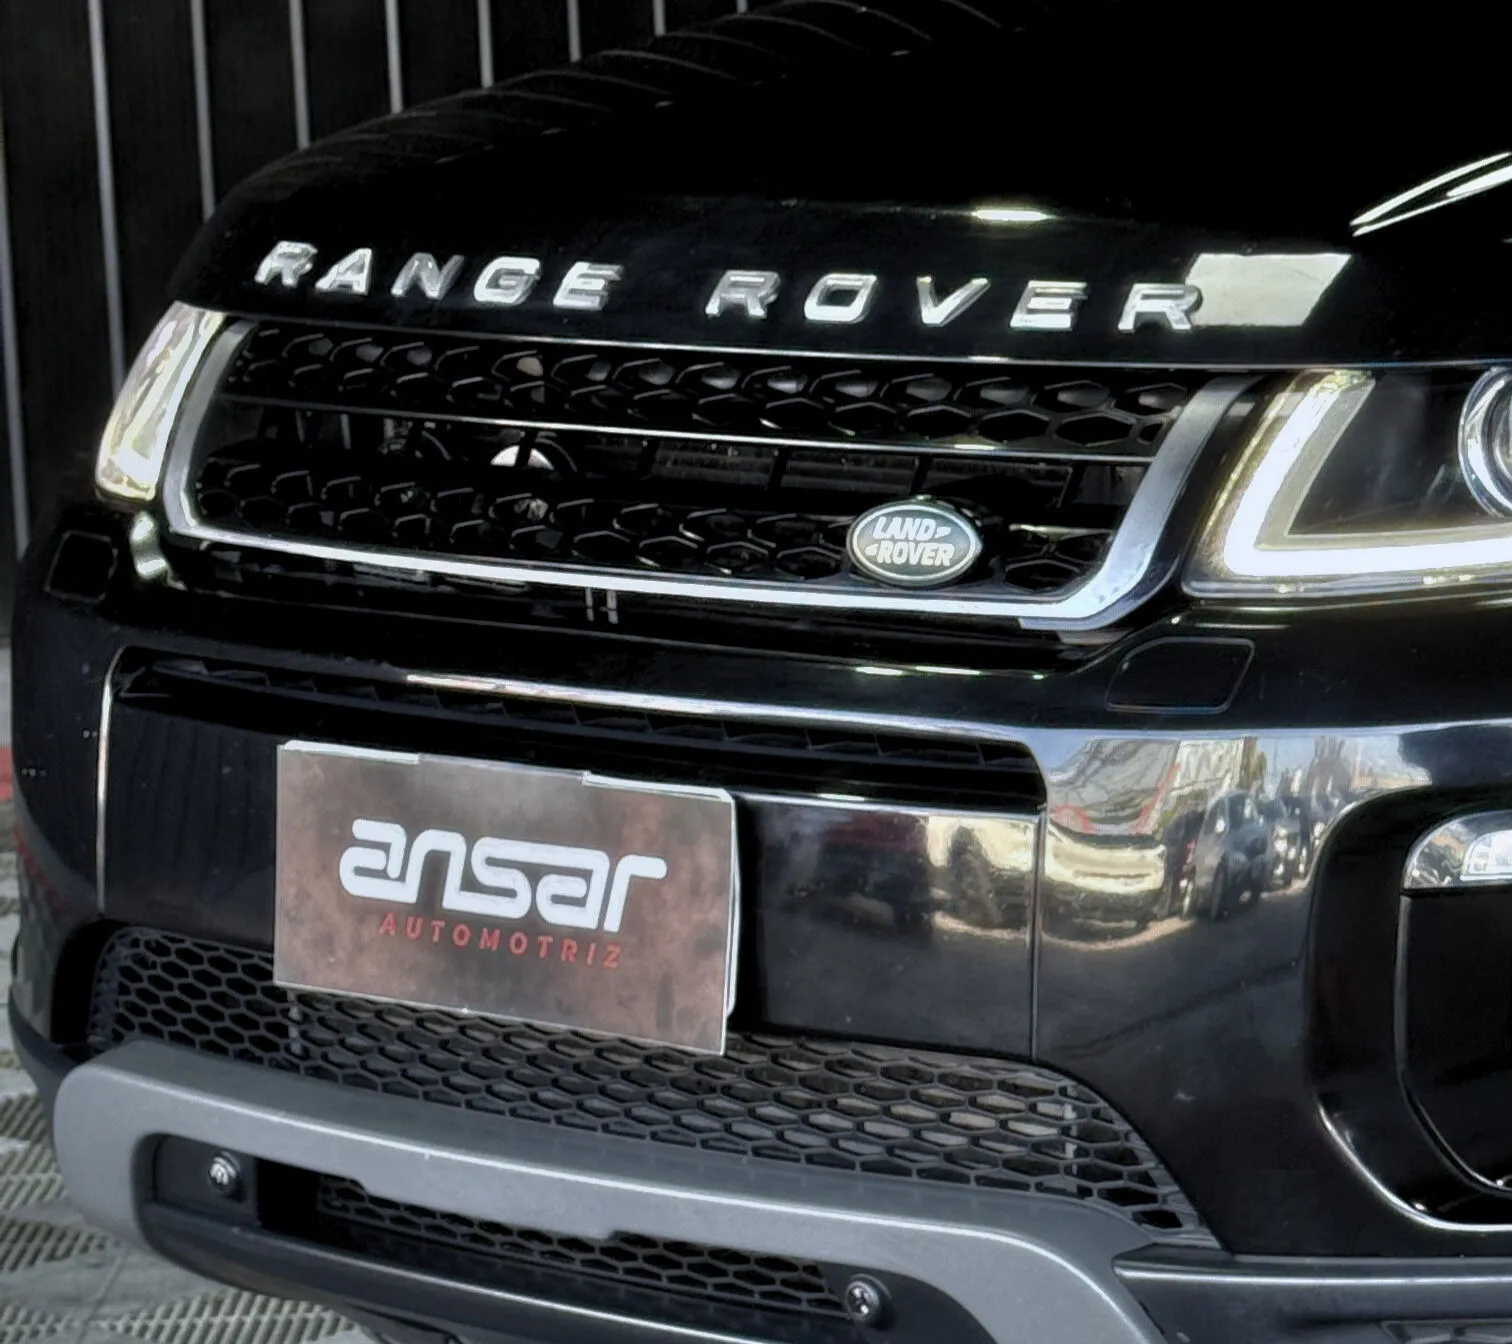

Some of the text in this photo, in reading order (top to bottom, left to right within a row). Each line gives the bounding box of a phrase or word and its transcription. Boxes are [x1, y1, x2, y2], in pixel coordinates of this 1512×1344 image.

[254, 240, 1202, 333] RANGE ROVER
[872, 516, 936, 541] LAND
[876, 540, 955, 566] ROVER
[339, 817, 668, 933] ansar
[378, 911, 623, 970] AUTOMOTRIZ
